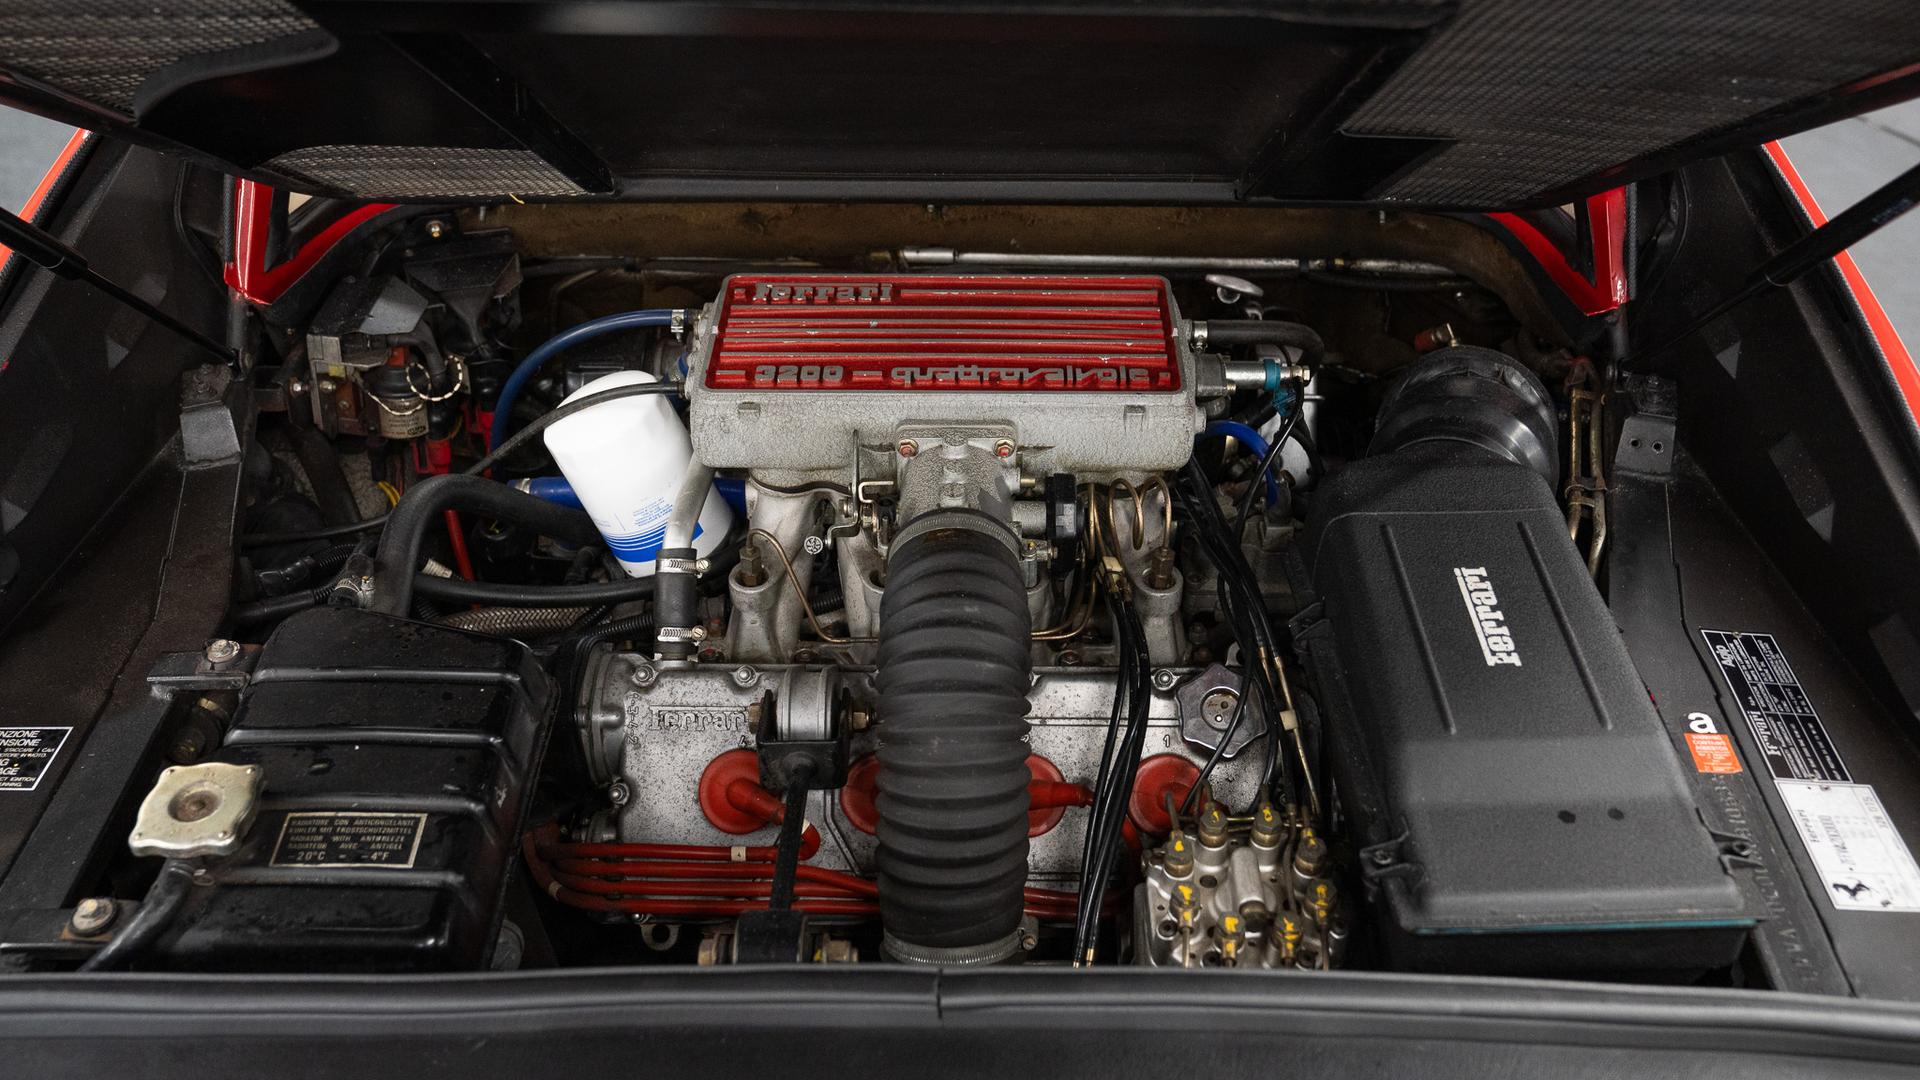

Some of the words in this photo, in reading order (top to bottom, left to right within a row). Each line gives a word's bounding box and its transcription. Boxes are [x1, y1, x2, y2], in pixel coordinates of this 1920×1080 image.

[754, 365, 844, 385] 3200
[891, 365, 1149, 387] quattrovalvole
[1453, 567, 1522, 667] Ferrari
[1715, 644, 1735, 667] Agip
[649, 705, 748, 731] Ferrar
[0, 730, 40, 738] NZIONE
